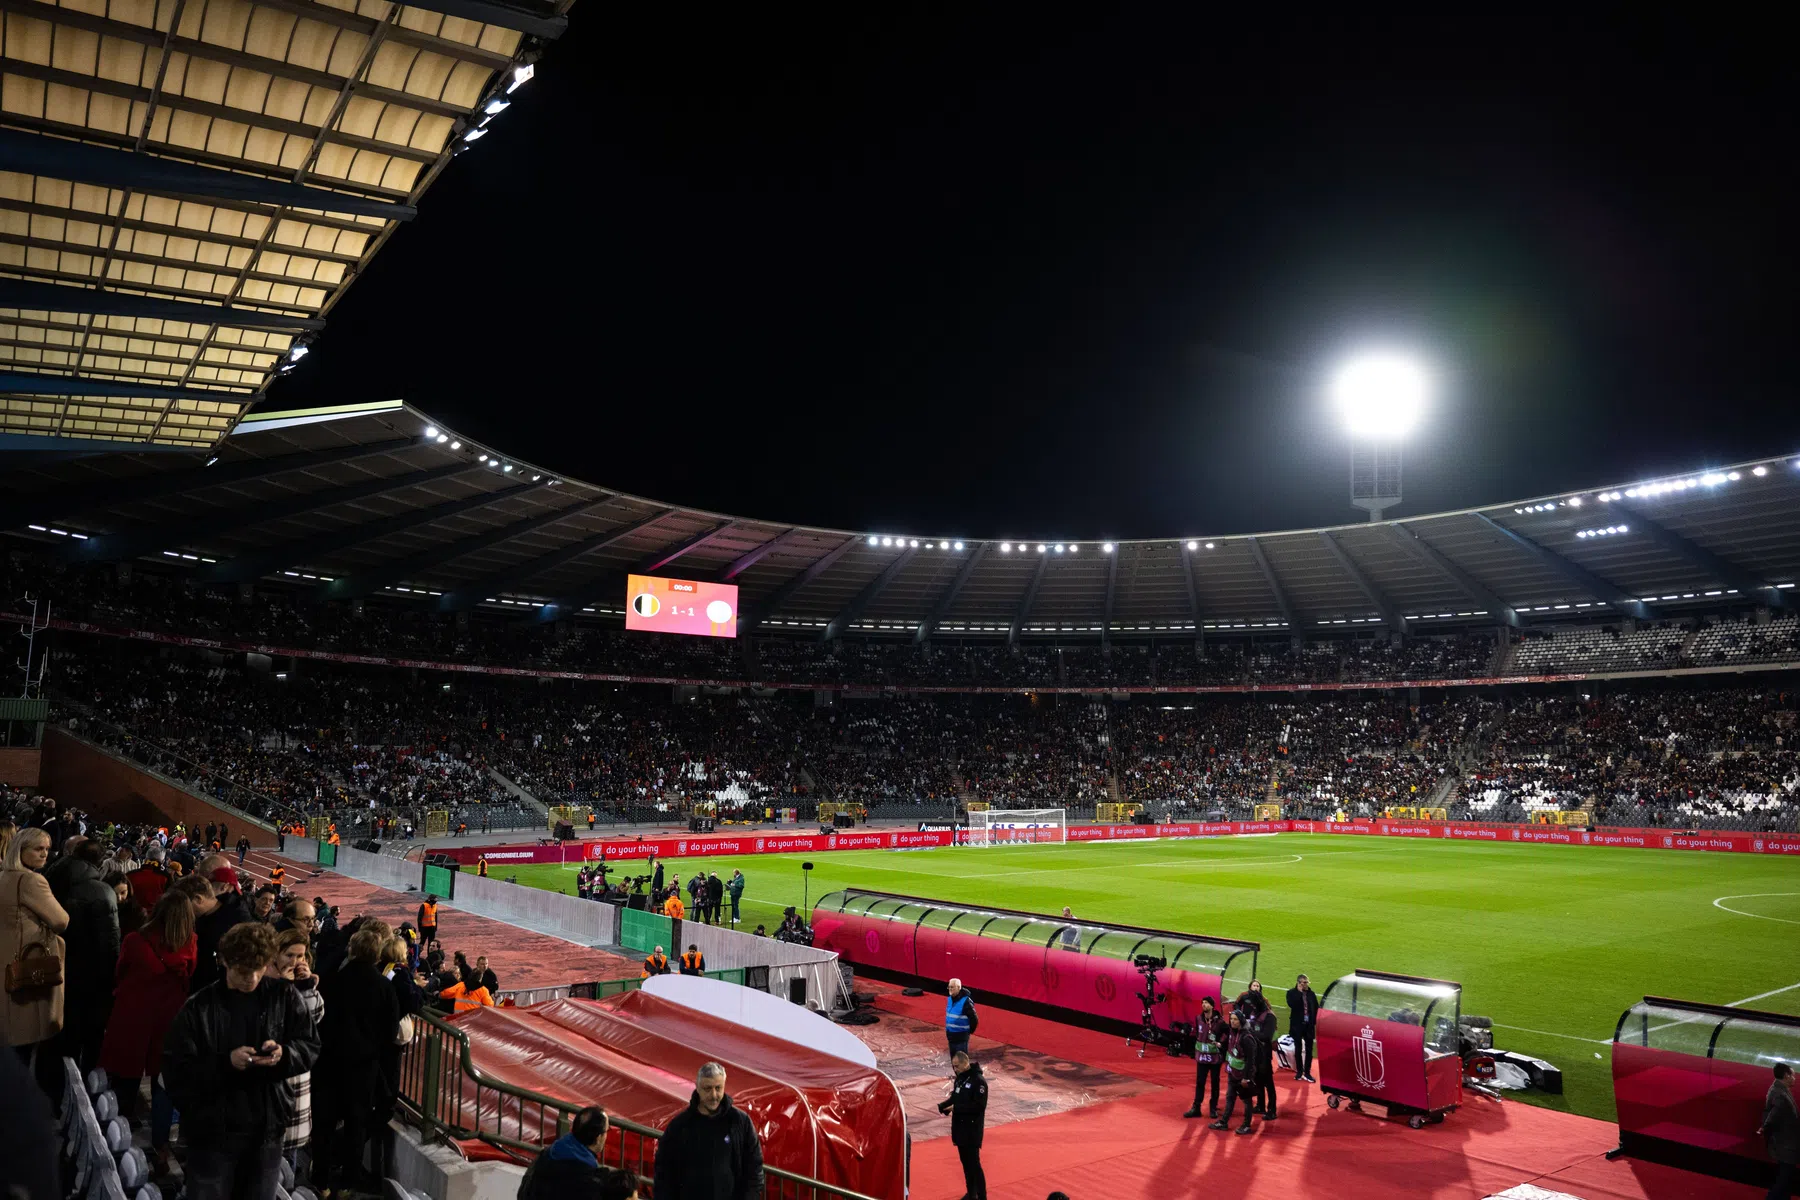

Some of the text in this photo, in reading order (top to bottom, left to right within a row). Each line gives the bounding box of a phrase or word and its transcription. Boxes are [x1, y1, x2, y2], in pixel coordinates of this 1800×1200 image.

[671, 605, 679, 615] 1
[687, 607, 695, 617] 1
[1134, 828, 1146, 836] thing
[1354, 824, 1370, 833] thing
[1414, 826, 1430, 835] thing
[1478, 829, 1497, 838] thing
[848, 838, 863, 846] your
[864, 836, 881, 845] thing
[909, 835, 922, 844] your
[924, 834, 940, 842] thing
[1534, 832, 1550, 840] your
[1550, 833, 1570, 842] thing
[1604, 836, 1622, 844] your
[1623, 836, 1644, 846] thing
[690, 841, 739, 852] do your thing
[768, 838, 813, 849] do your thing
[1689, 840, 1708, 848] your
[1710, 840, 1733, 850] thing
[1782, 843, 1800, 852] you
[606, 844, 659, 856] do your thing
